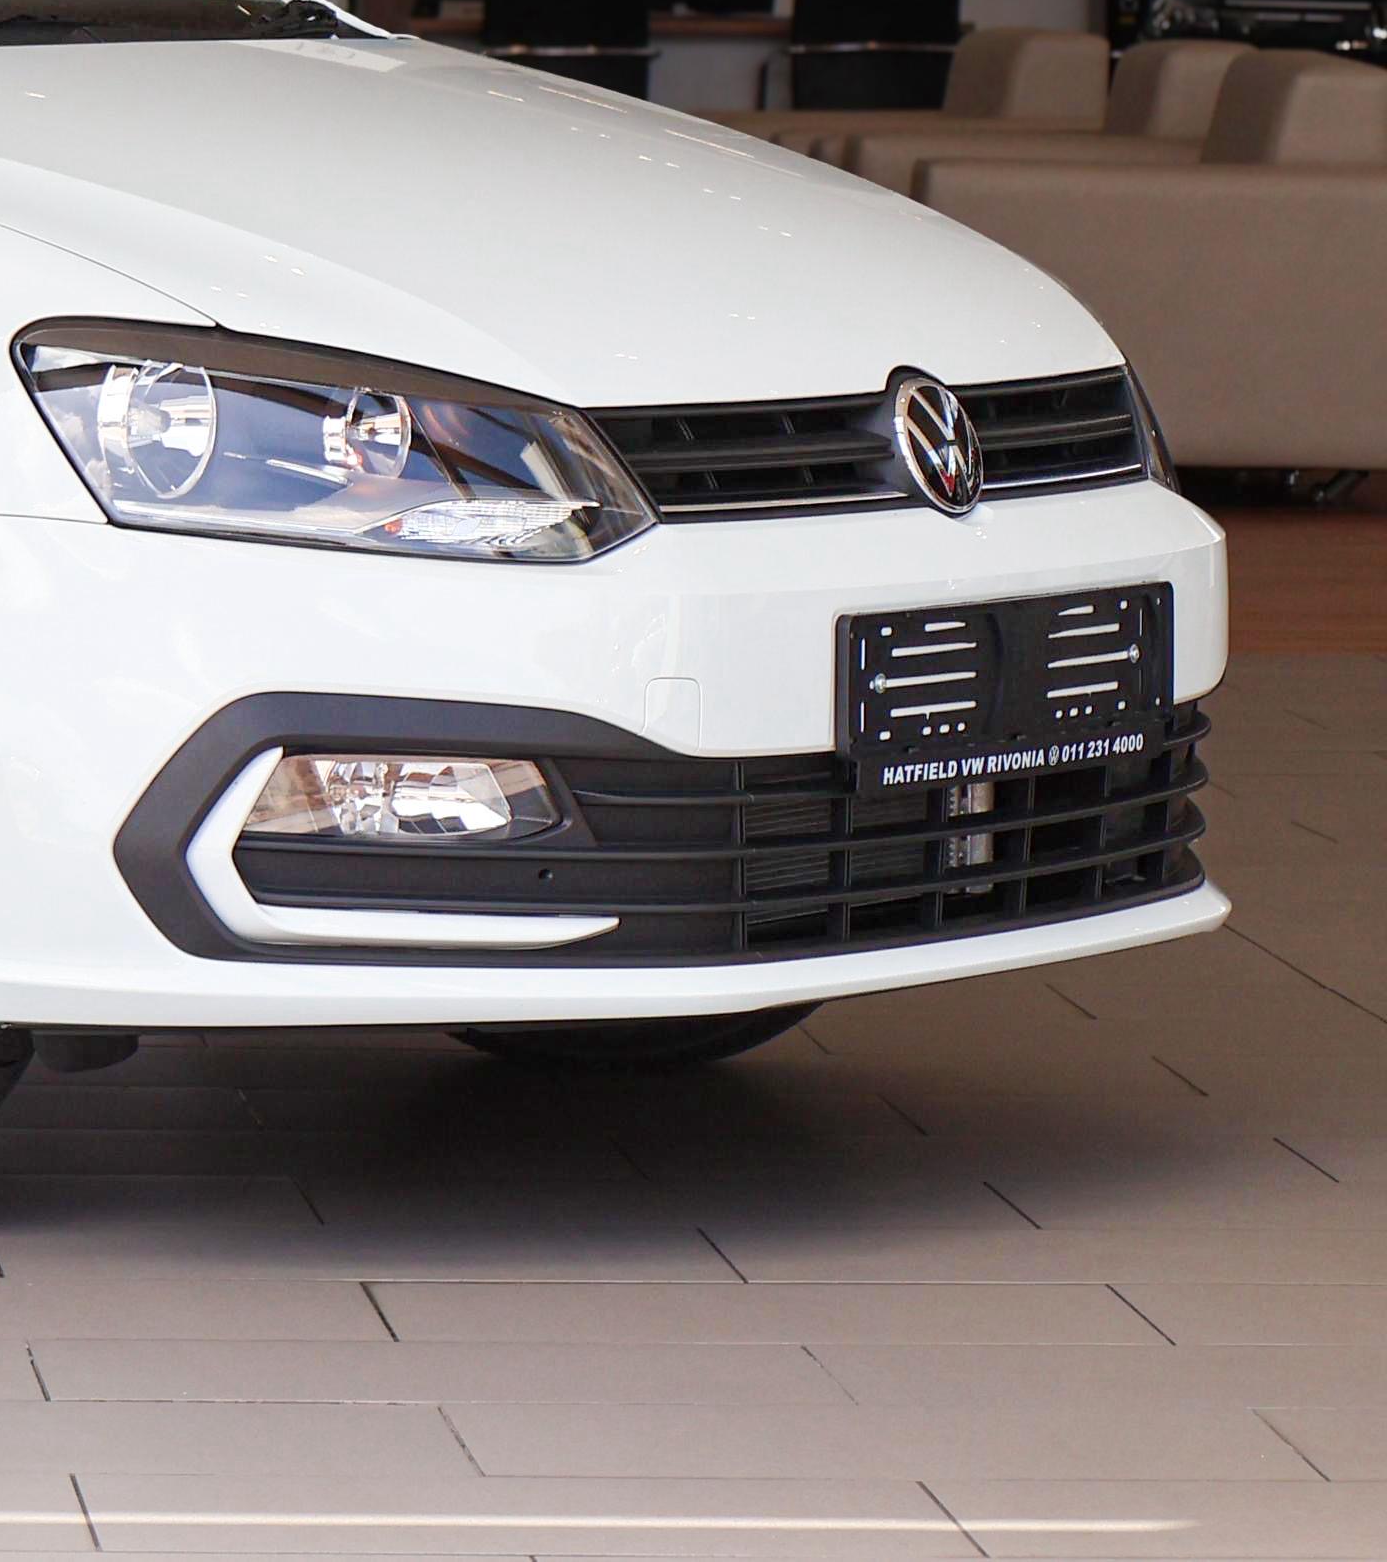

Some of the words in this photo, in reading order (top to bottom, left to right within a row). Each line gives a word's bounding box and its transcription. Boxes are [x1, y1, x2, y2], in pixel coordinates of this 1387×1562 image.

[895, 377, 984, 515] VW
[882, 760, 958, 786] HATFIELD
[961, 756, 986, 777] VW
[986, 749, 1045, 774] RIVONIA
[1062, 745, 1085, 763] 011
[1087, 739, 1110, 759] 231
[1112, 733, 1144, 754] 4000
